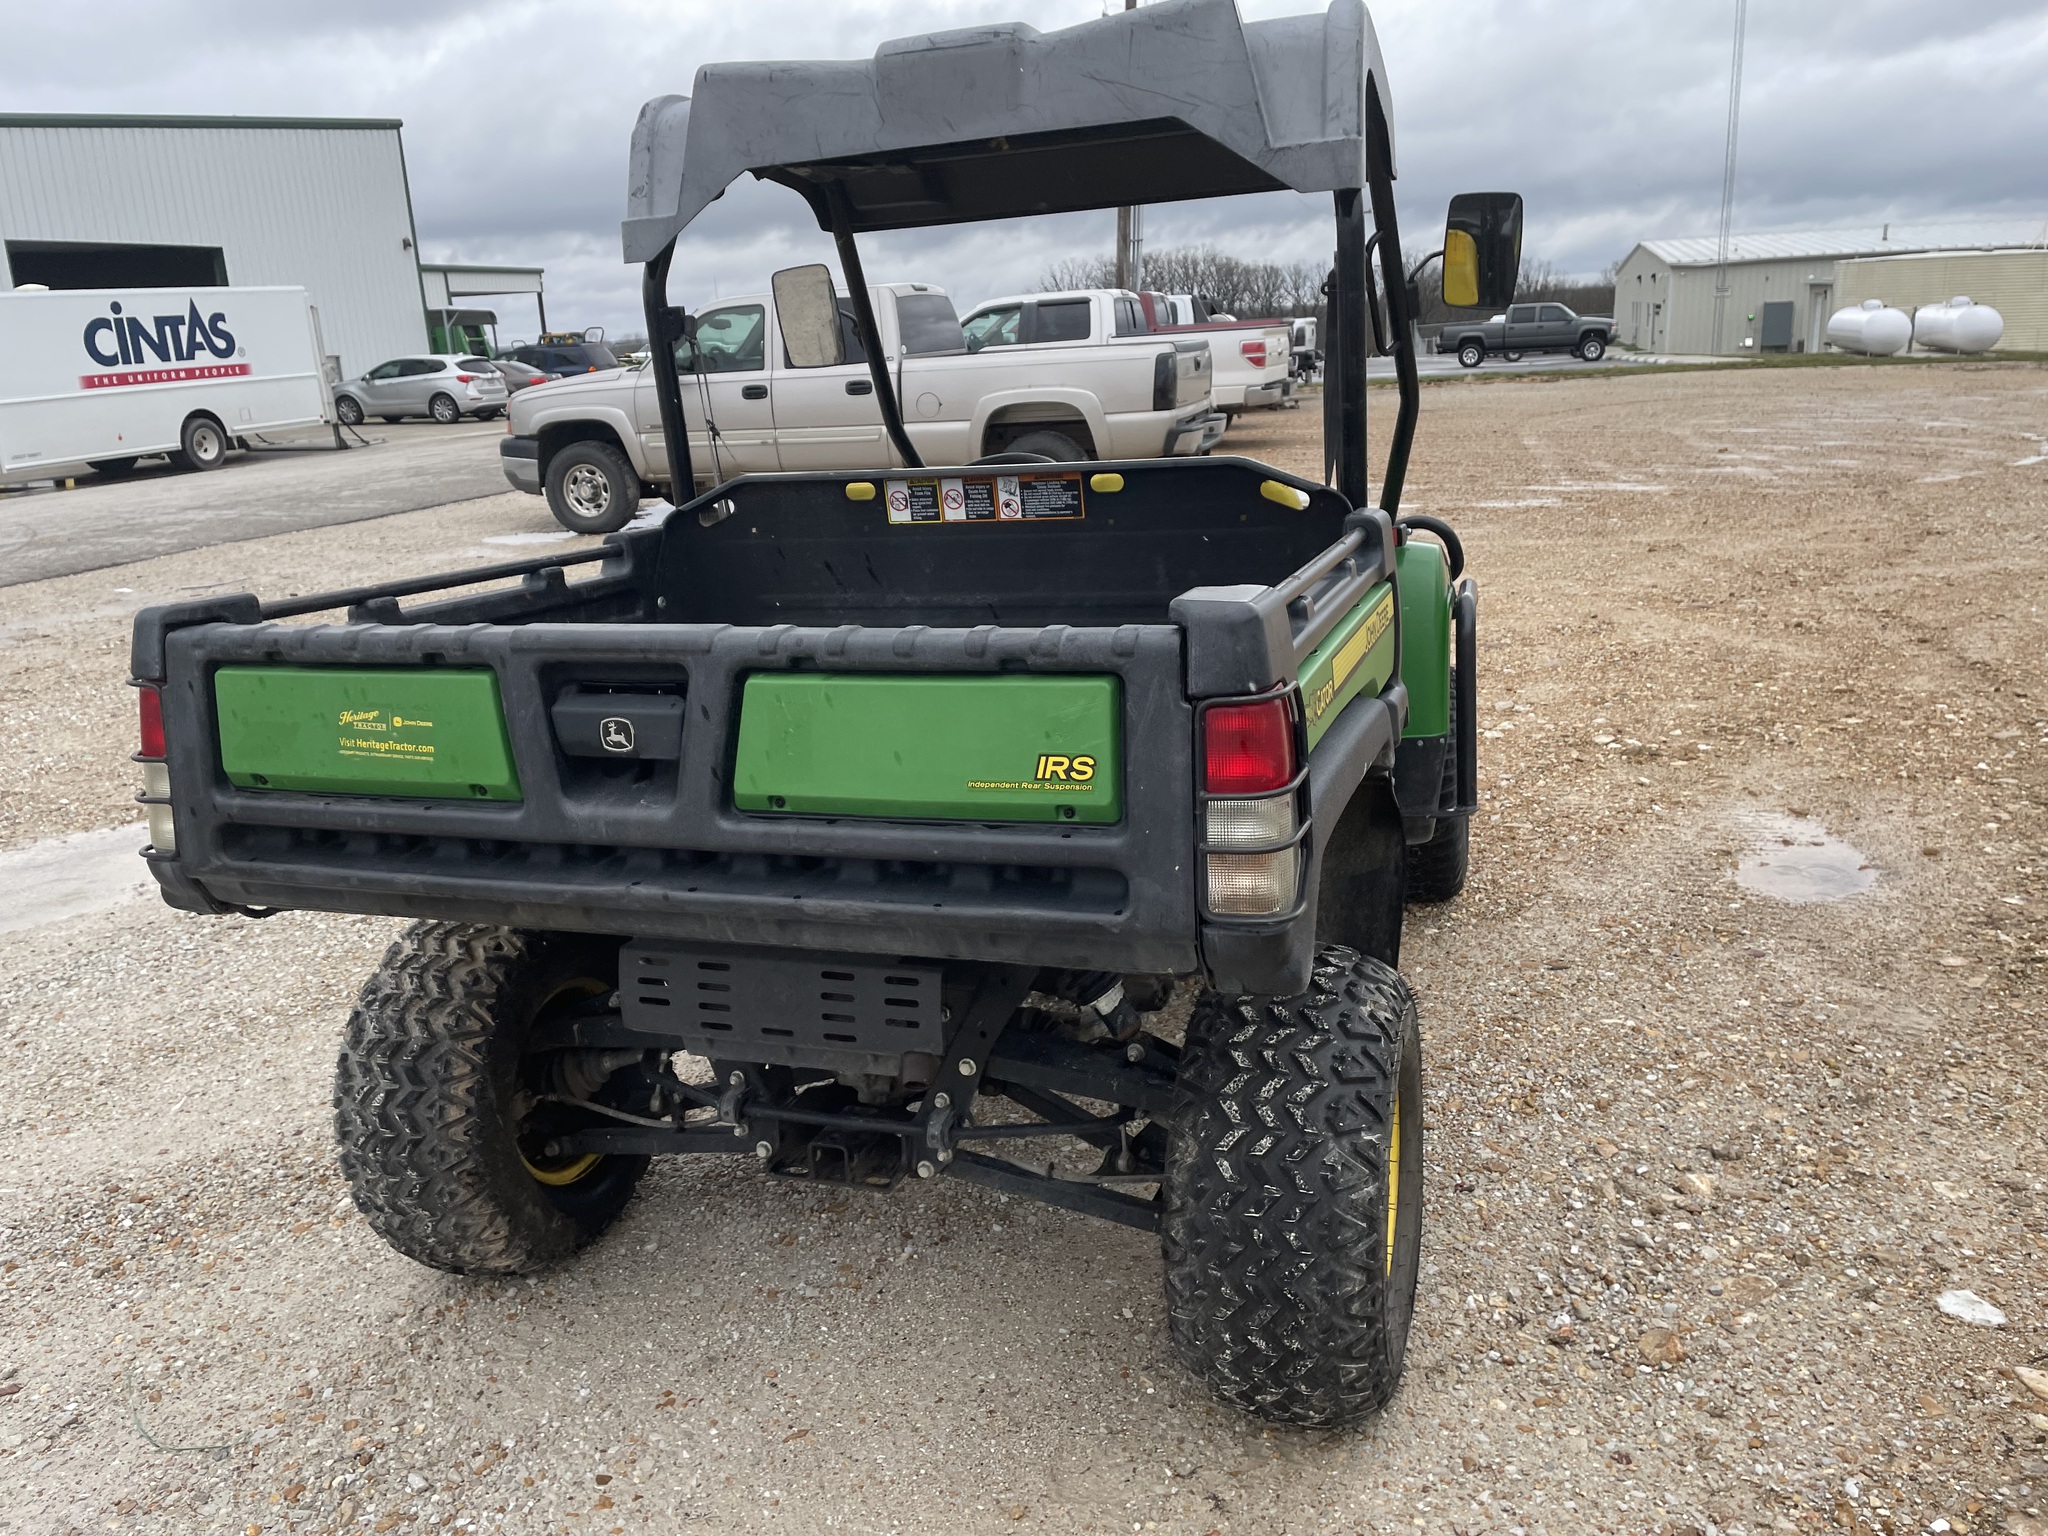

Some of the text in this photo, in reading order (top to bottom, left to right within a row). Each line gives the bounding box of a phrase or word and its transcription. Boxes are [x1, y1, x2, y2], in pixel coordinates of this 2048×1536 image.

[84, 298, 236, 366] CINTAS
[94, 366, 241, 386] THE UNIFORM PEOPLE
[339, 709, 380, 726] Heritage
[339, 737, 435, 753] Visit HeritageTractor.com
[1035, 754, 1097, 782] IRS
[967, 780, 1093, 791] Independent Rear Suspension
